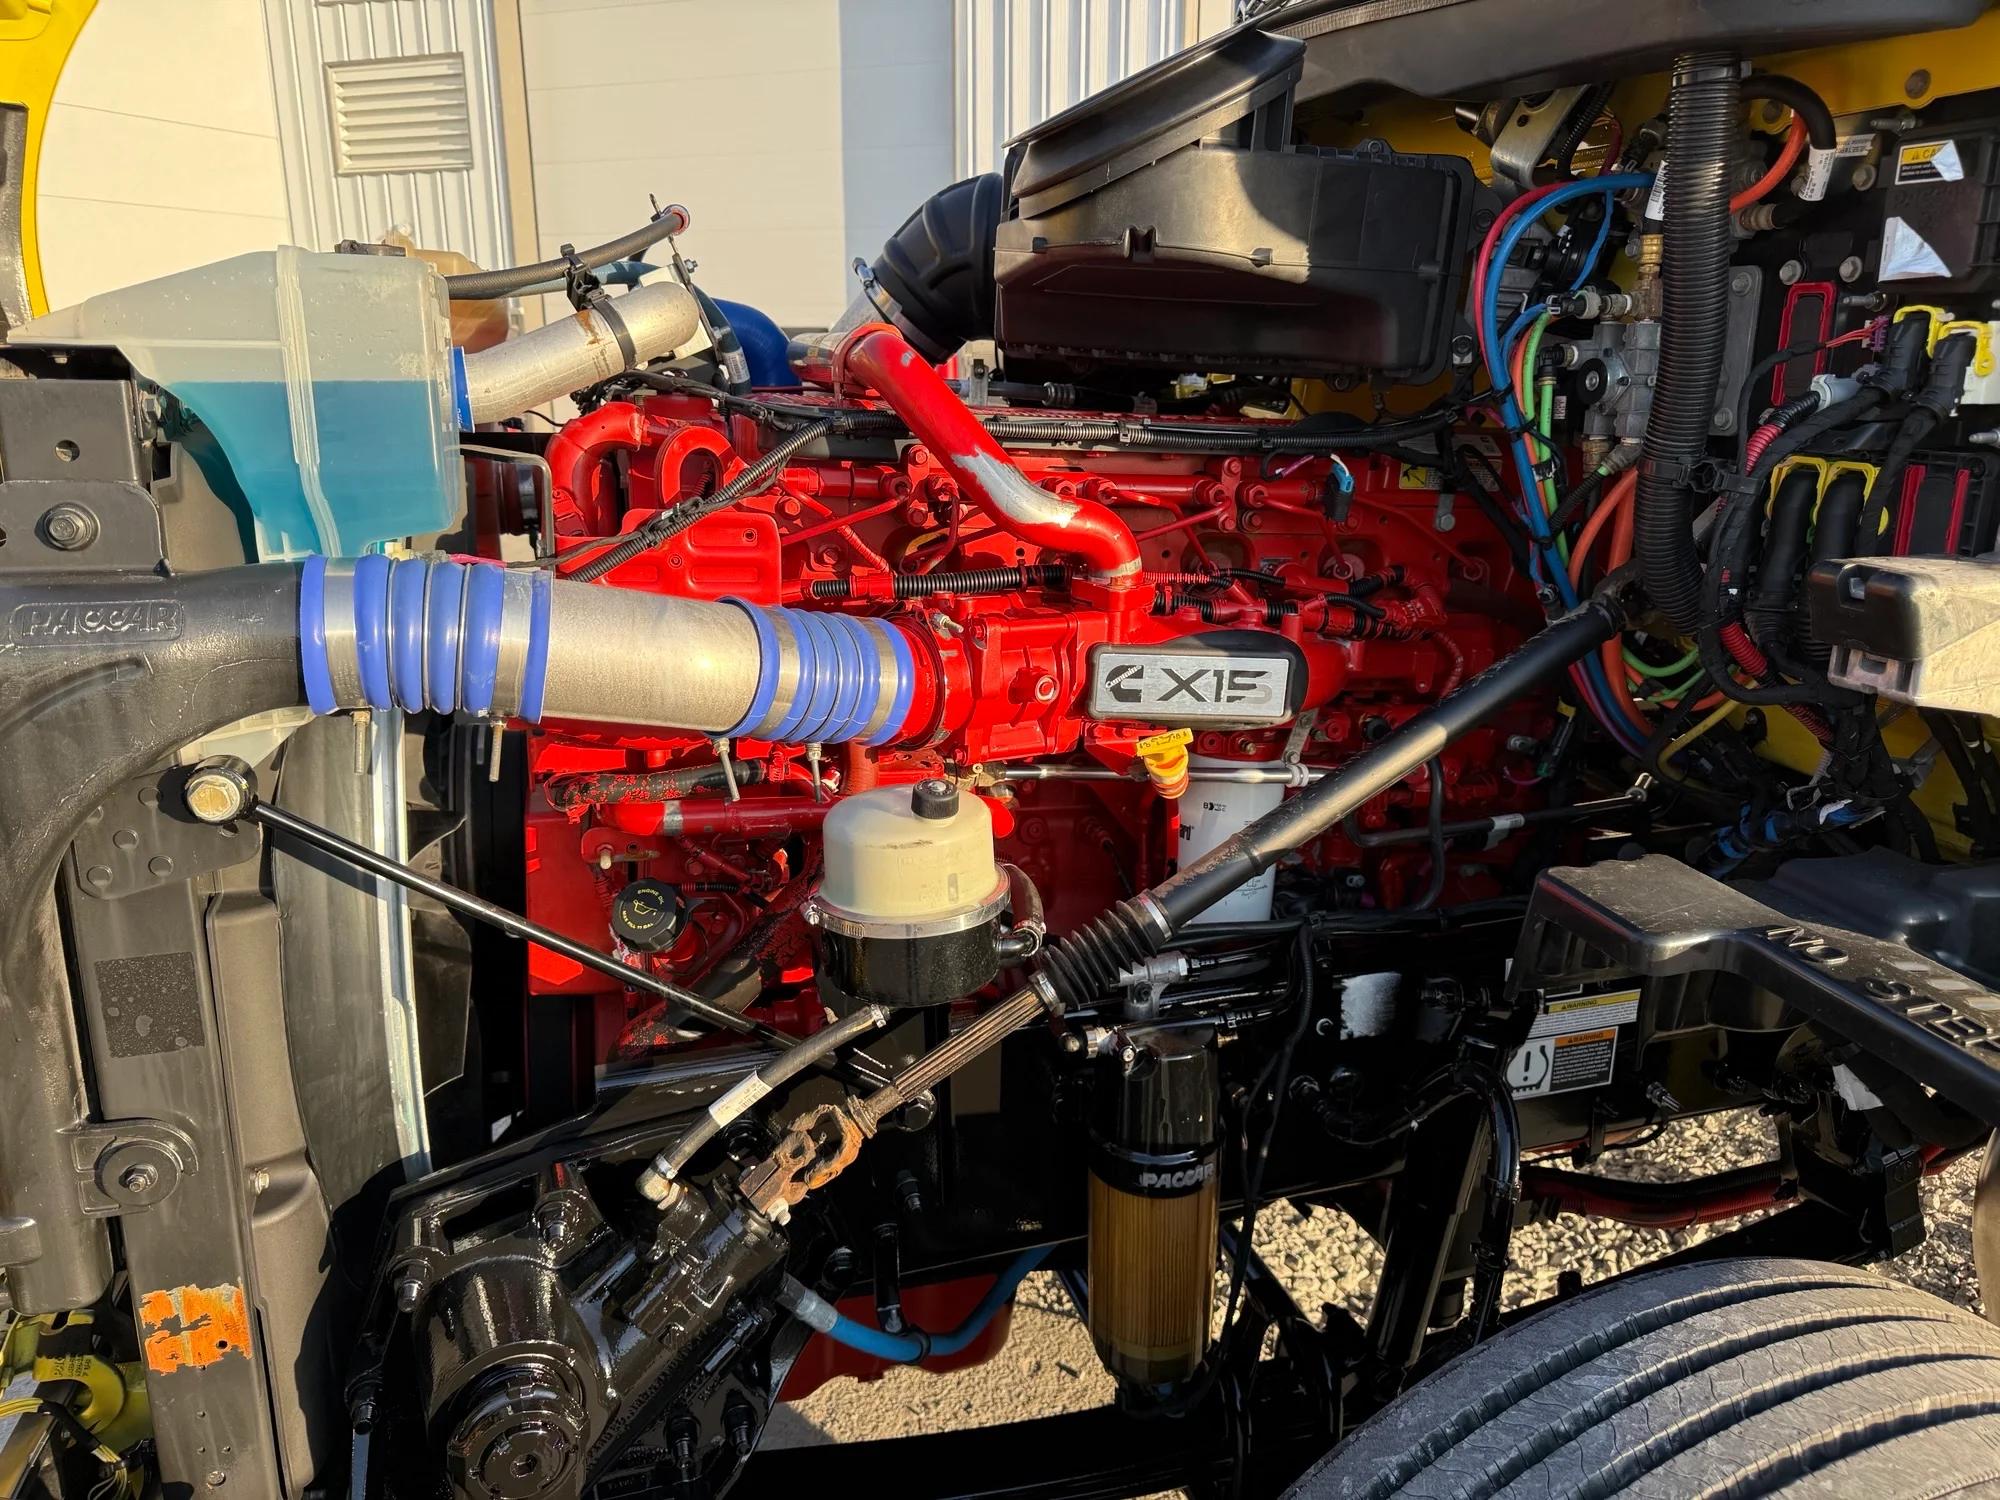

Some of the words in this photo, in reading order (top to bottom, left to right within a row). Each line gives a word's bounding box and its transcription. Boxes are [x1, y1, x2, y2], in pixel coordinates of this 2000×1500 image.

[21, 606, 178, 636] PACCAR
[1156, 668, 1273, 704] X15
[637, 889, 659, 897] ENGINE
[1767, 926, 1849, 964] NO
[1566, 1000, 1597, 1009] WARNING
[1573, 1032, 1603, 1042] WARNING
[1143, 1163, 1213, 1188] PACCAR
